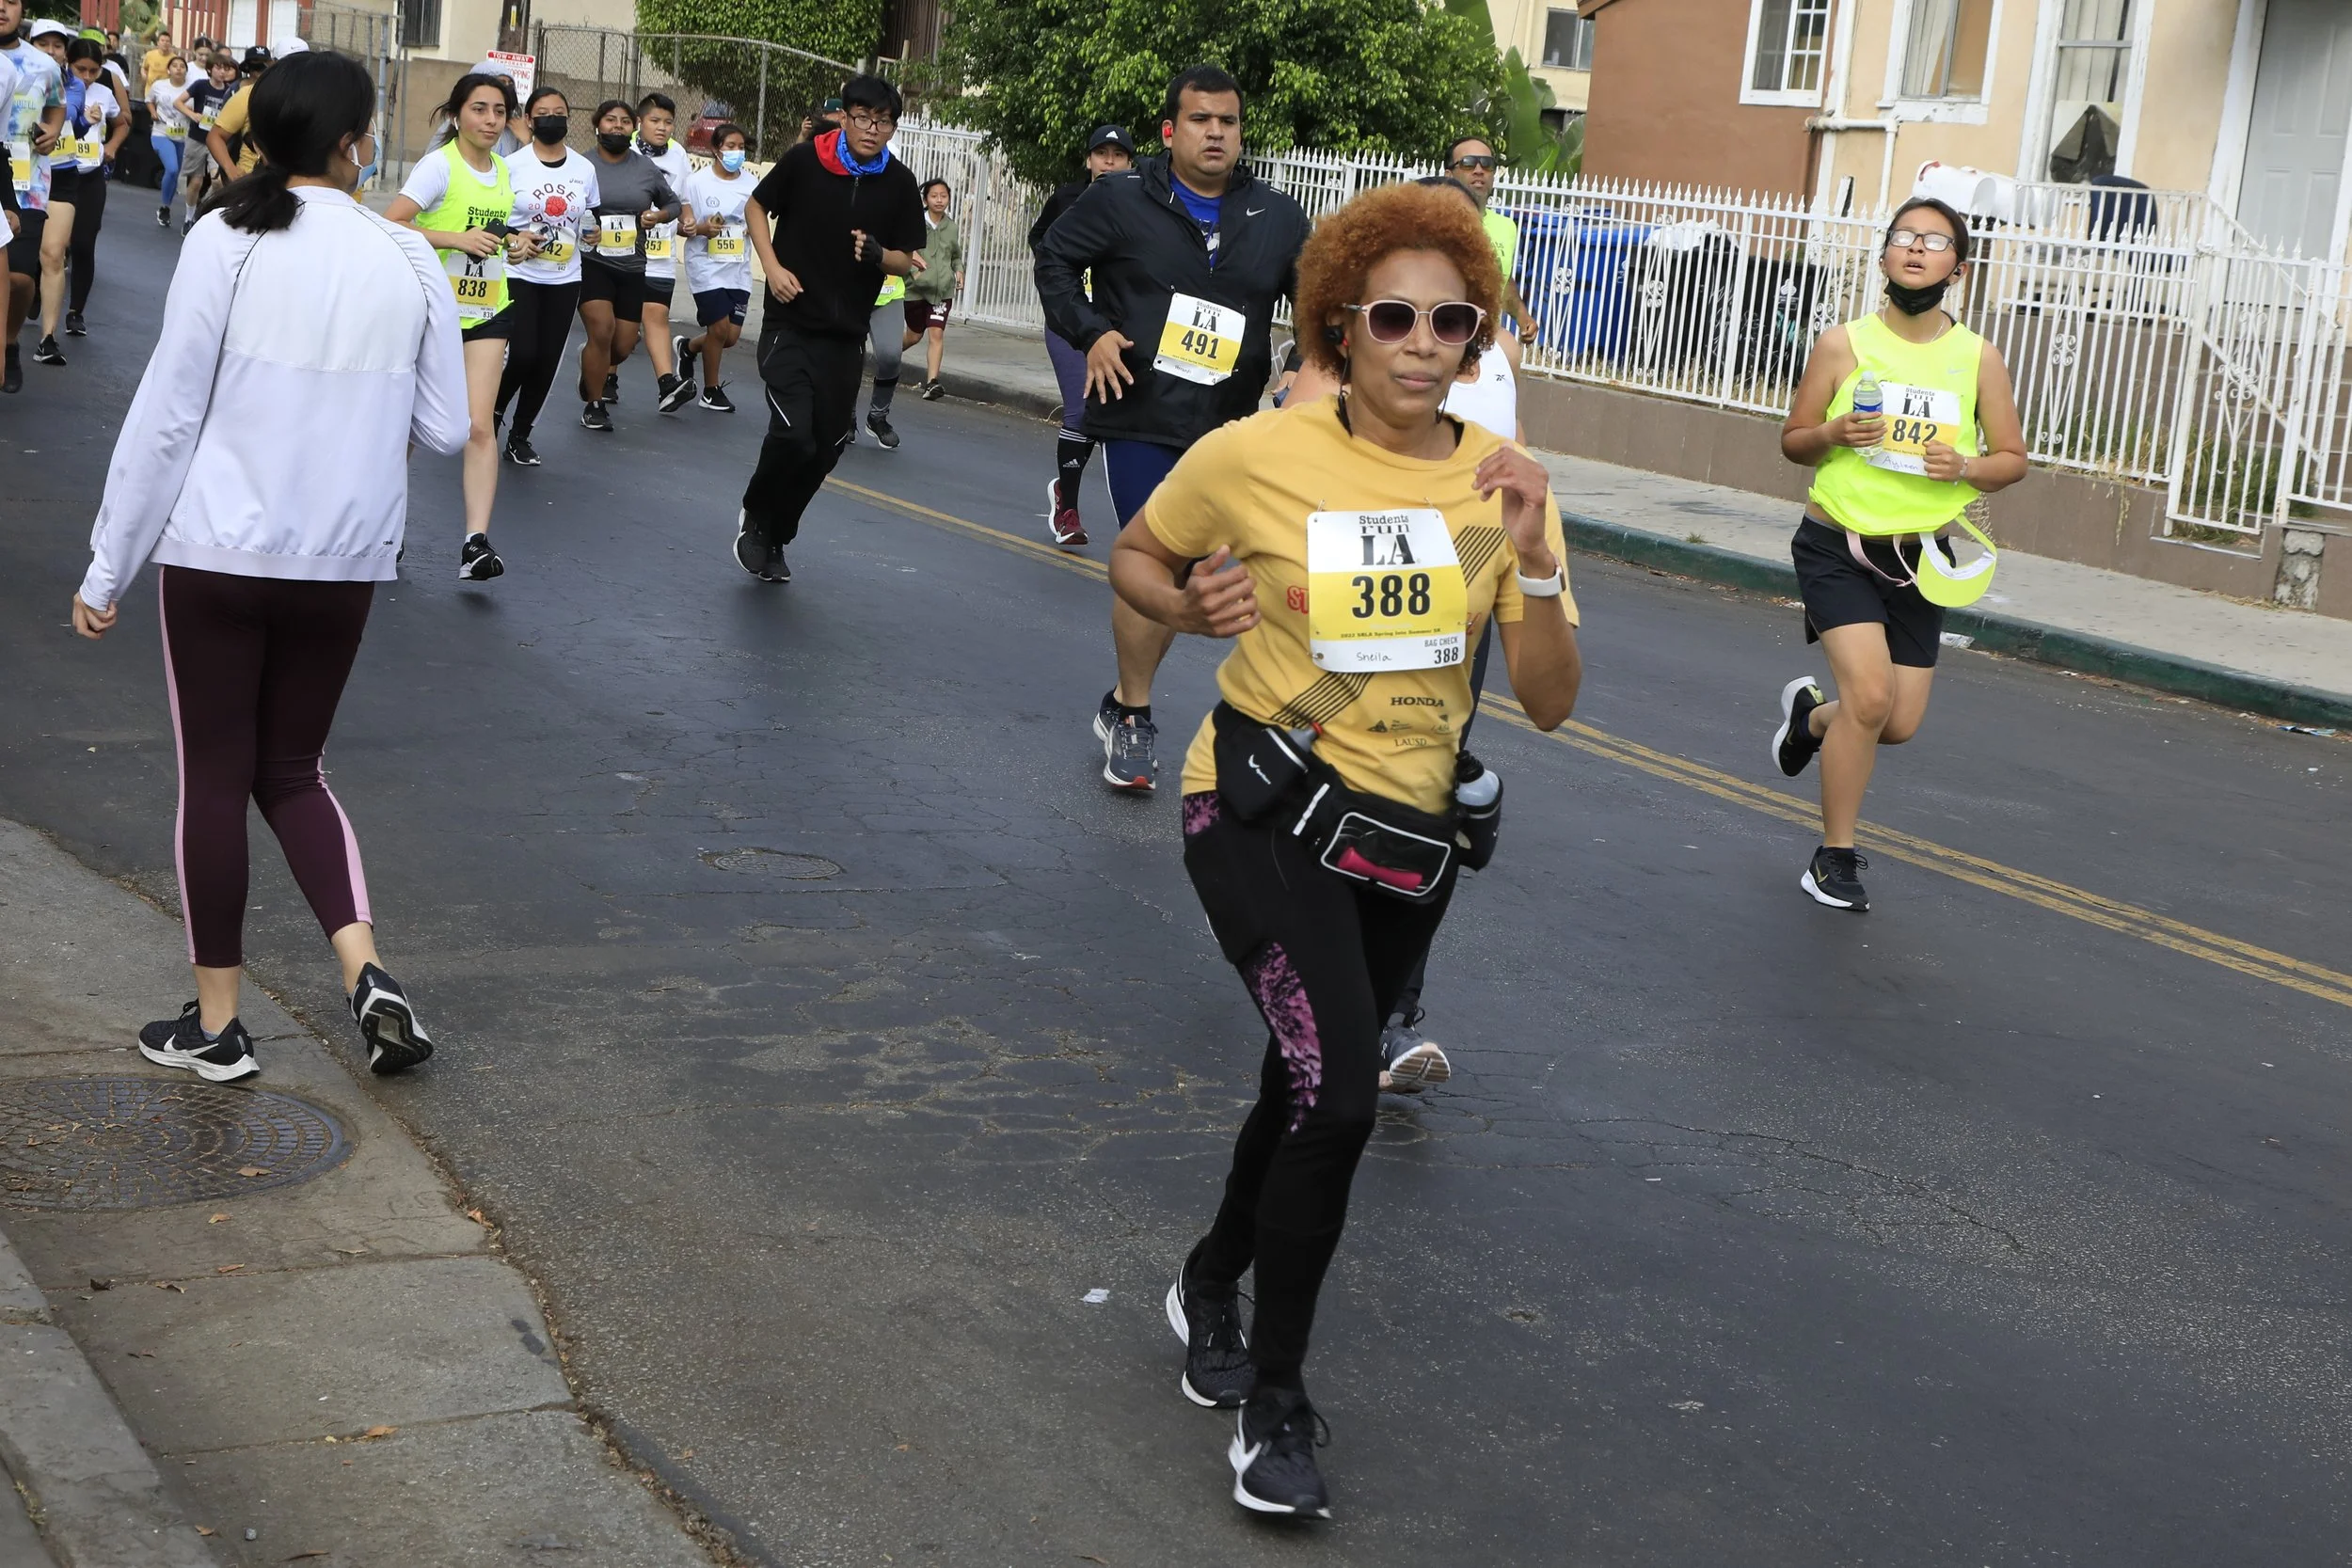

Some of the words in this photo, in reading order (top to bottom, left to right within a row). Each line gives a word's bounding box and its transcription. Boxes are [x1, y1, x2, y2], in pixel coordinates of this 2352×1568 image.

[532, 182, 577, 201] ROSE
[468, 206, 507, 218] Students
[611, 221, 624, 230] LA
[614, 231, 621, 244] 6
[717, 239, 735, 250] 556
[465, 263, 485, 277] LA
[457, 278, 487, 298] 838
[1192, 309, 1216, 332] LA
[1181, 329, 1219, 359] 491
[1905, 388, 1935, 397] Students
[1901, 398, 1931, 418] LA
[1892, 419, 1938, 445] 842
[1359, 515, 1409, 525] Students
[1361, 523, 1410, 534] run
[1360, 533, 1416, 566] LA
[1351, 572, 1431, 619] 388
[1424, 639, 1438, 648] BAG
[1438, 636, 1458, 646] CHECK
[1434, 646, 1459, 664] 388
[1391, 696, 1445, 707] HONDA
[1394, 736, 1427, 747] LAUSD
